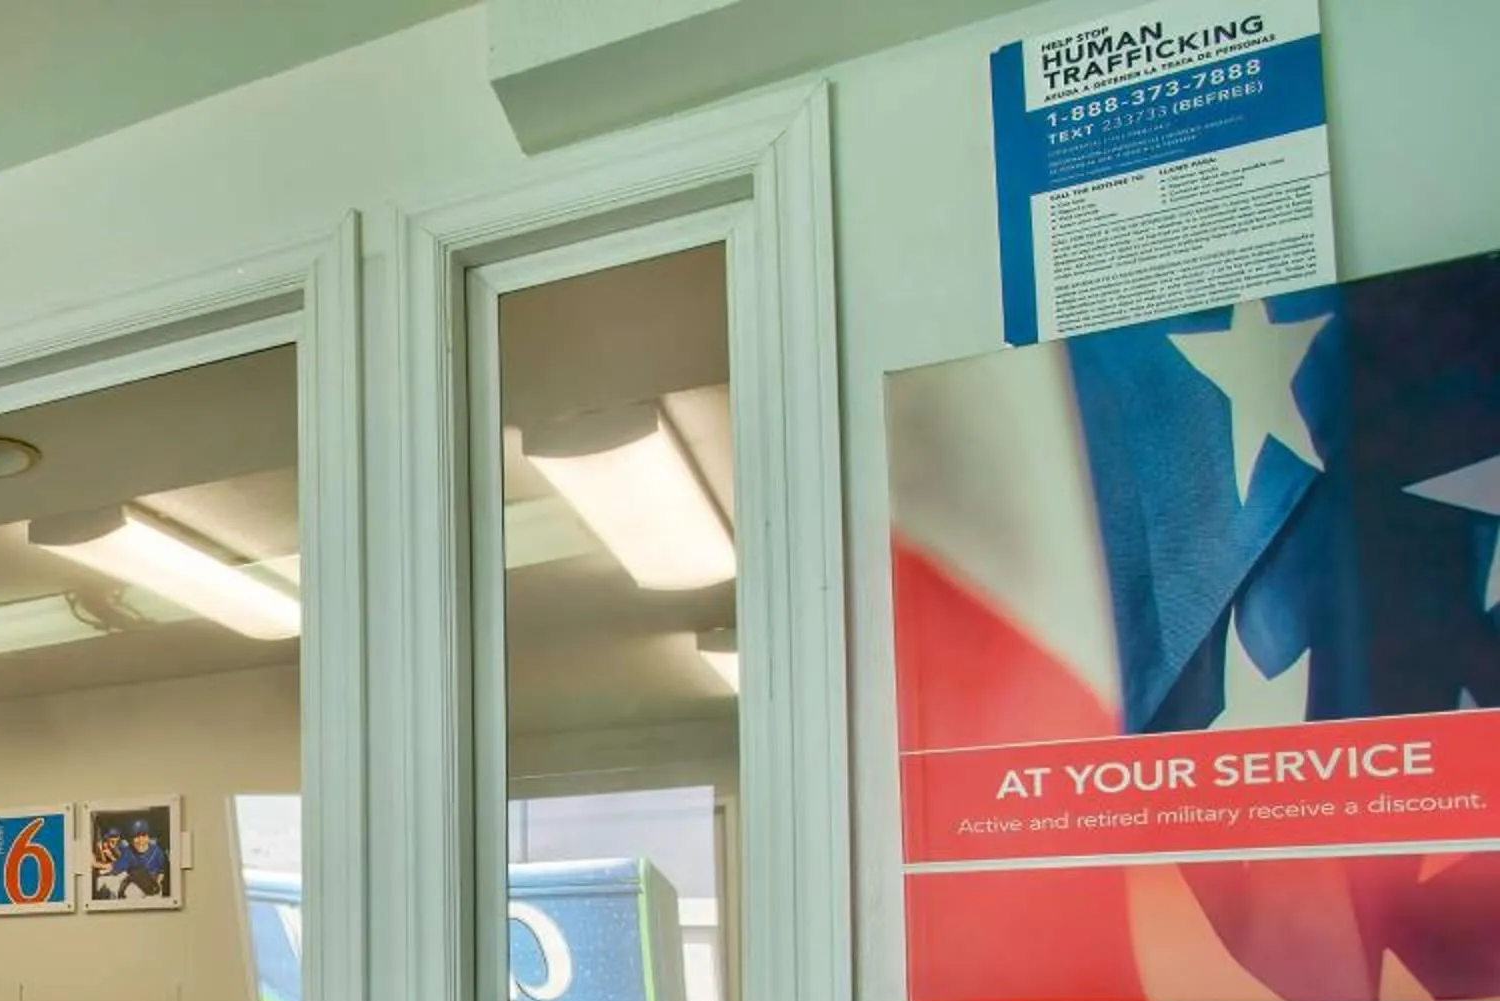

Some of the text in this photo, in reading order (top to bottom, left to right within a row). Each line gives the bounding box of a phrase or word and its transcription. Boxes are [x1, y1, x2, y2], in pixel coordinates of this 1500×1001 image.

[1041, 26, 1109, 53] HELP STOP
[1042, 22, 1163, 70] HUMAN
[1043, 15, 1264, 89] TRAFFICKING
[1198, 51, 1212, 60] DE
[1047, 58, 1262, 127] 1-888-373-7888
[1049, 123, 1094, 144] TEXT
[1173, 79, 1264, 115] (BEFREE)
[996, 741, 1435, 799] AT YOUR SERVICE
[957, 791, 1488, 835] Active and retired military receive a discount.
[3, 817, 56, 904] 6
